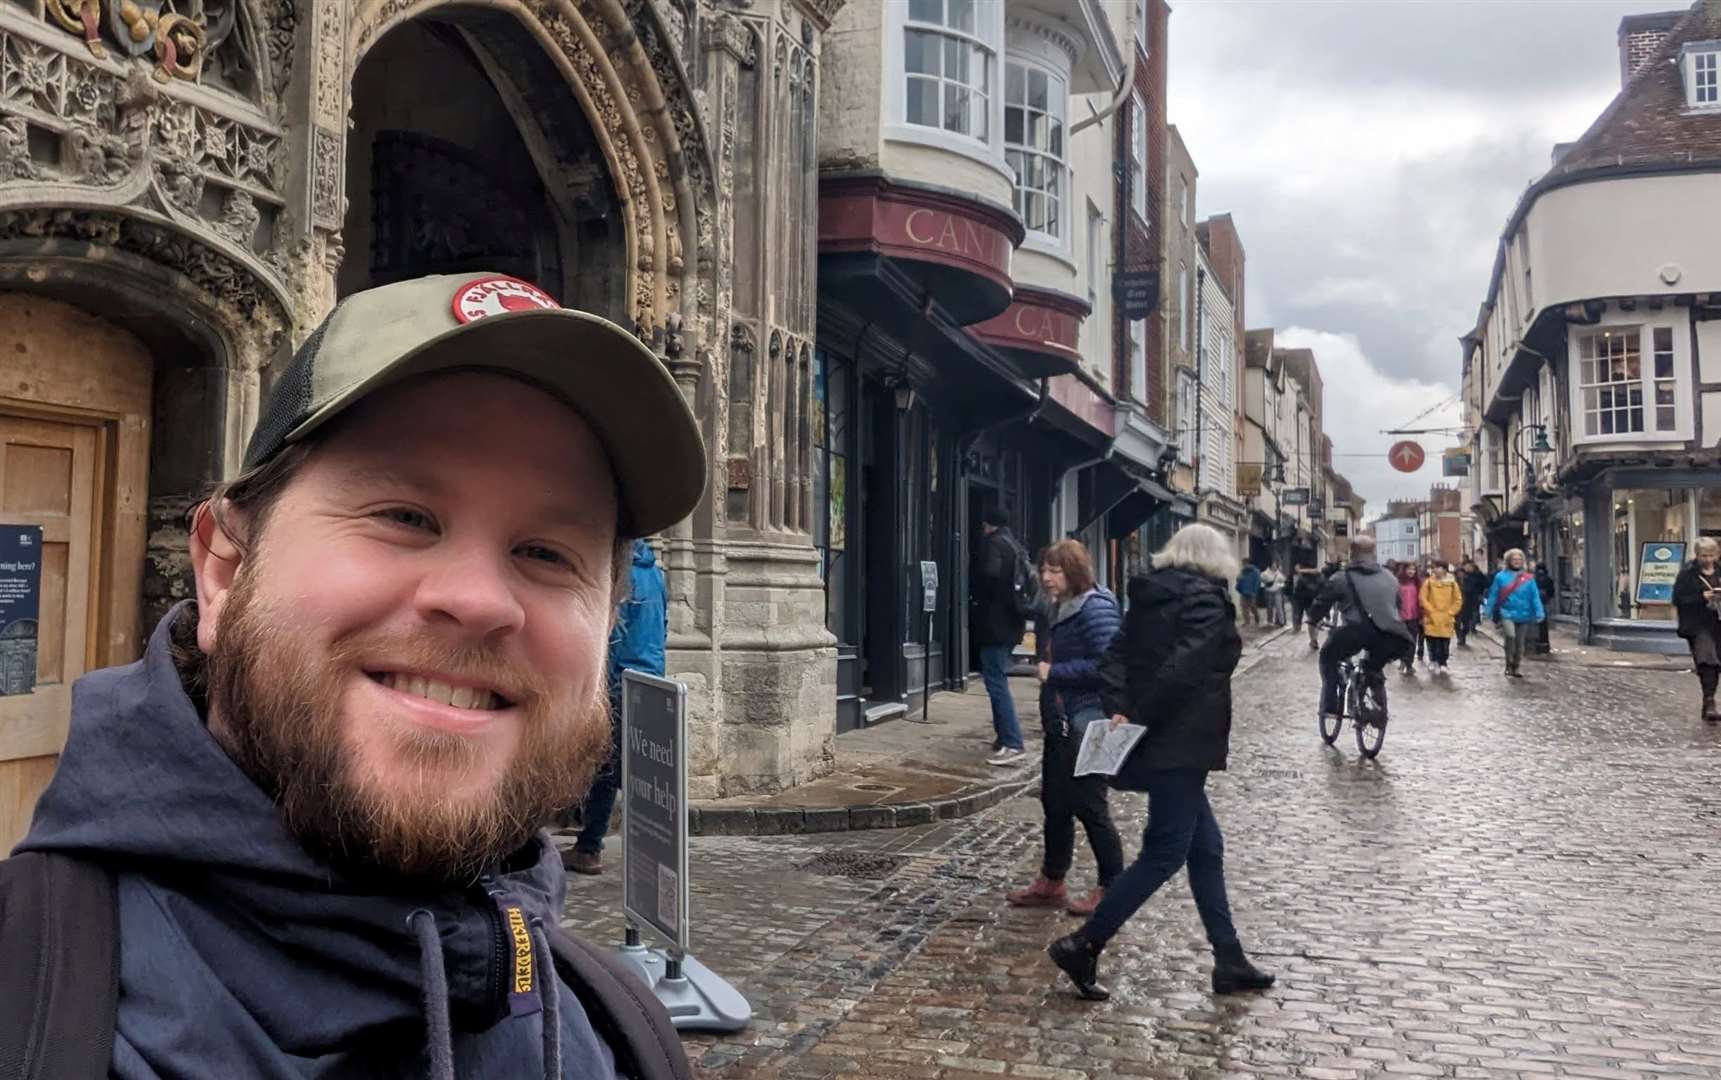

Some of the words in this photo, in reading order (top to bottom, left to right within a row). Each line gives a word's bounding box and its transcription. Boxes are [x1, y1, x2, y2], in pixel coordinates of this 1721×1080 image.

[905, 208, 998, 262] CAN
[628, 725, 648, 757] We
[649, 739, 674, 768] need
[627, 774, 653, 802] your
[654, 775, 677, 822] help
